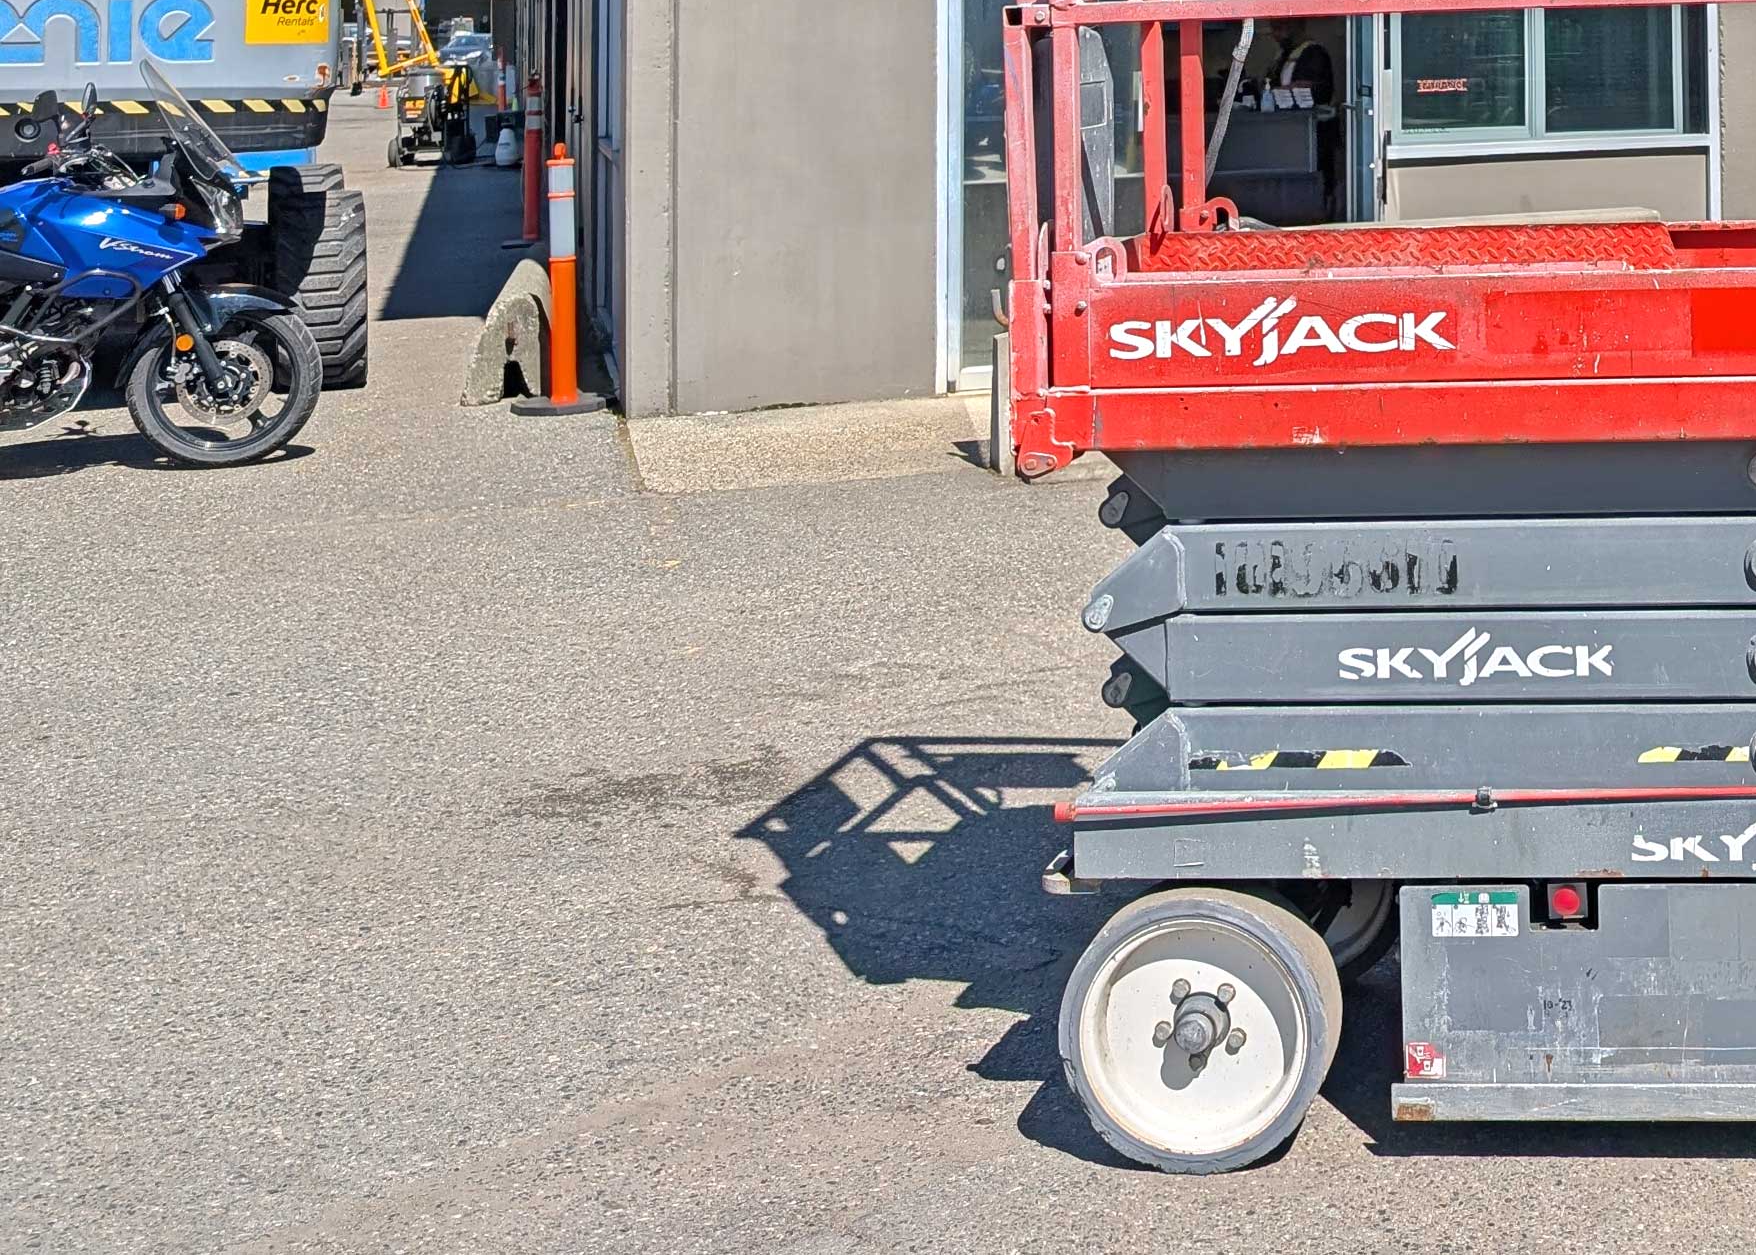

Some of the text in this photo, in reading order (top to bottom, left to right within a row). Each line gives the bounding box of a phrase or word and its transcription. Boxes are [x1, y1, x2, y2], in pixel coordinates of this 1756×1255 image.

[277, 16, 315, 27] Rentals
[1109, 295, 1456, 366] SKYJACK
[1338, 627, 1614, 686] SKYJACK
